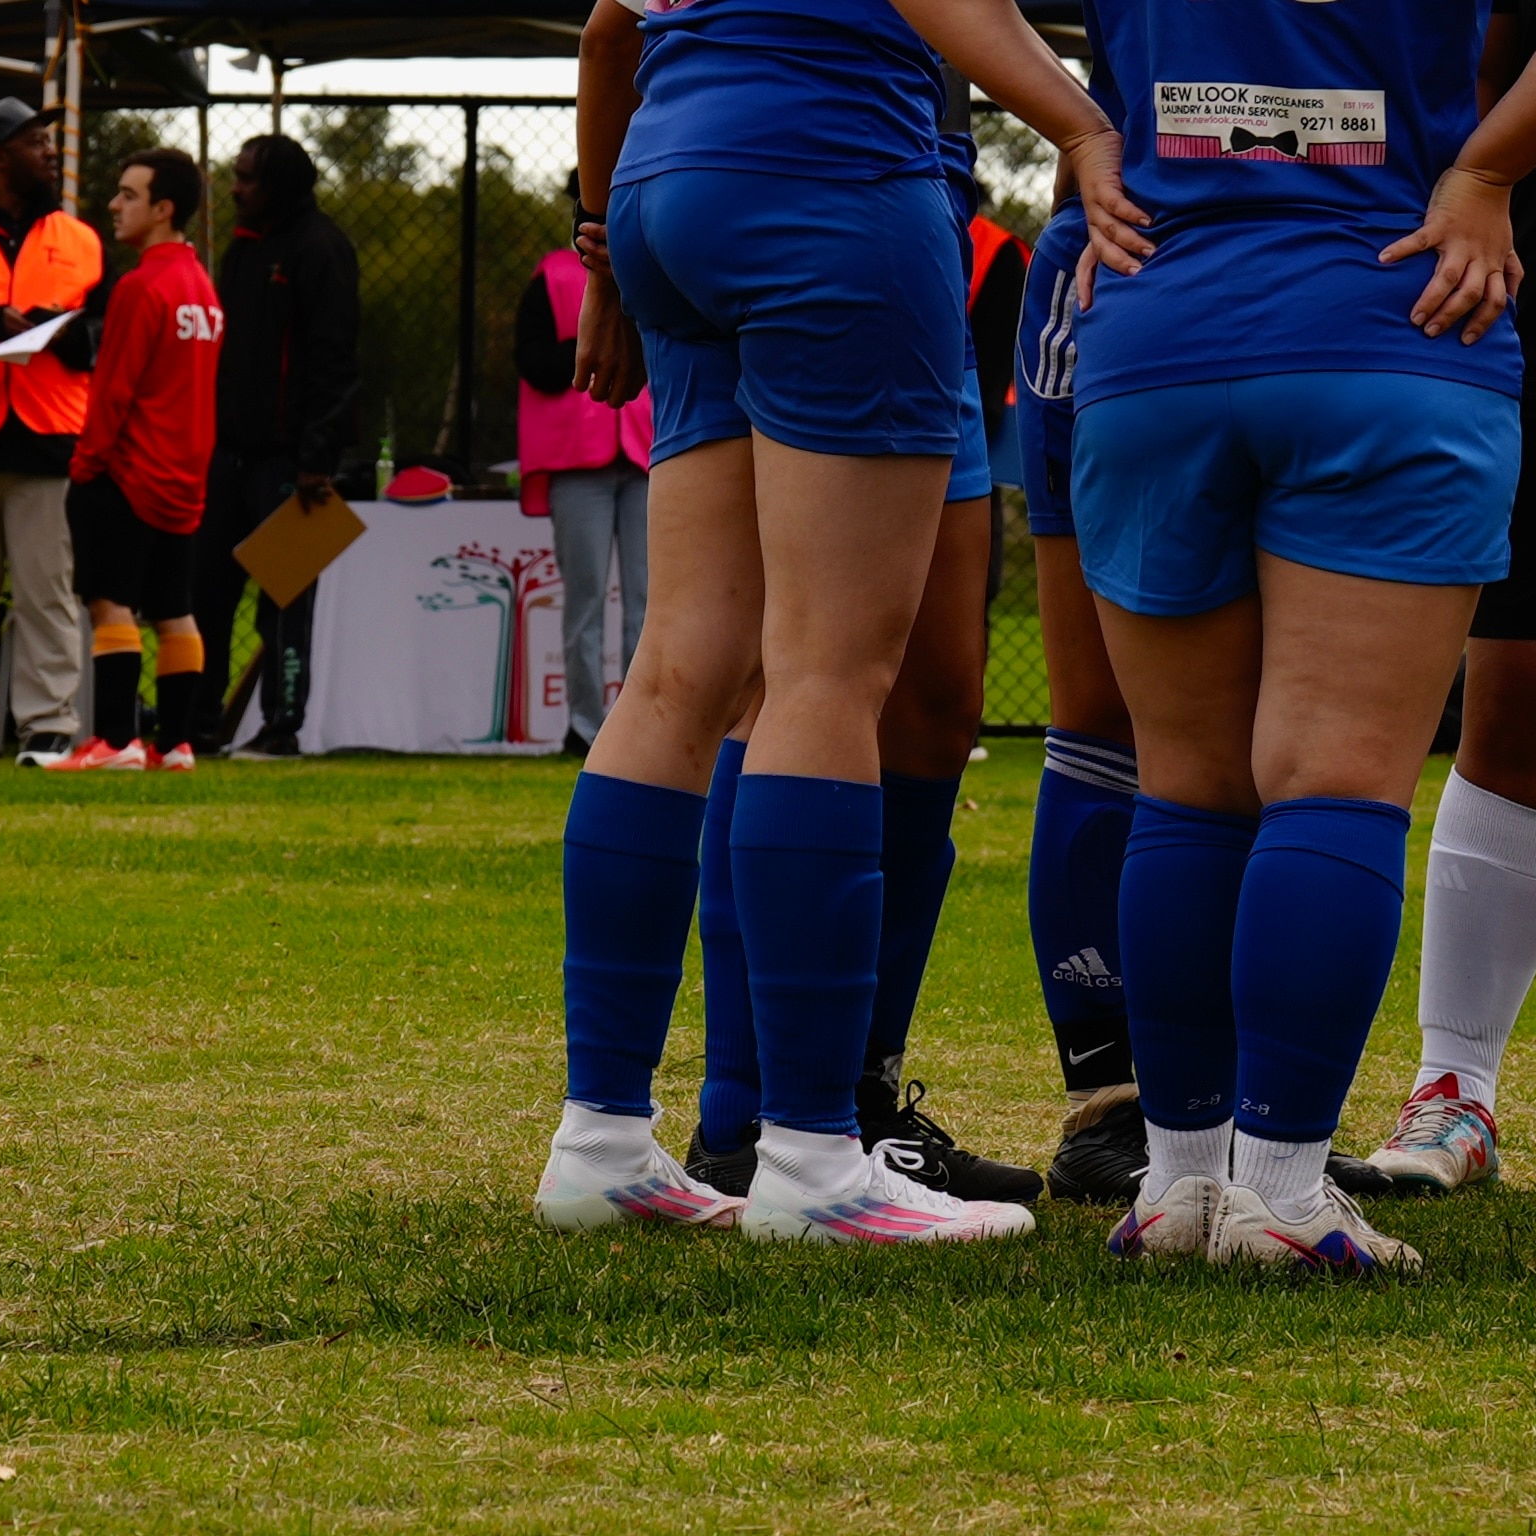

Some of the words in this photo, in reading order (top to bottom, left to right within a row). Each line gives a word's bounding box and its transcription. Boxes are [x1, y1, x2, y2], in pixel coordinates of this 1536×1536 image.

[1161, 86, 1192, 103] NEW
[1197, 86, 1250, 104] LOOK
[1254, 95, 1324, 110] DRYCLEANERS
[1161, 105, 1202, 115] LAUNDRY
[1204, 105, 1211, 115] &
[1214, 106, 1246, 116] LINEN
[1248, 106, 1290, 119] SERVICE
[1300, 117, 1334, 131] 9271
[1340, 118, 1376, 132] 8881
[1052, 969, 1123, 988] adidas
[1202, 1195, 1210, 1239] TIEMPO
